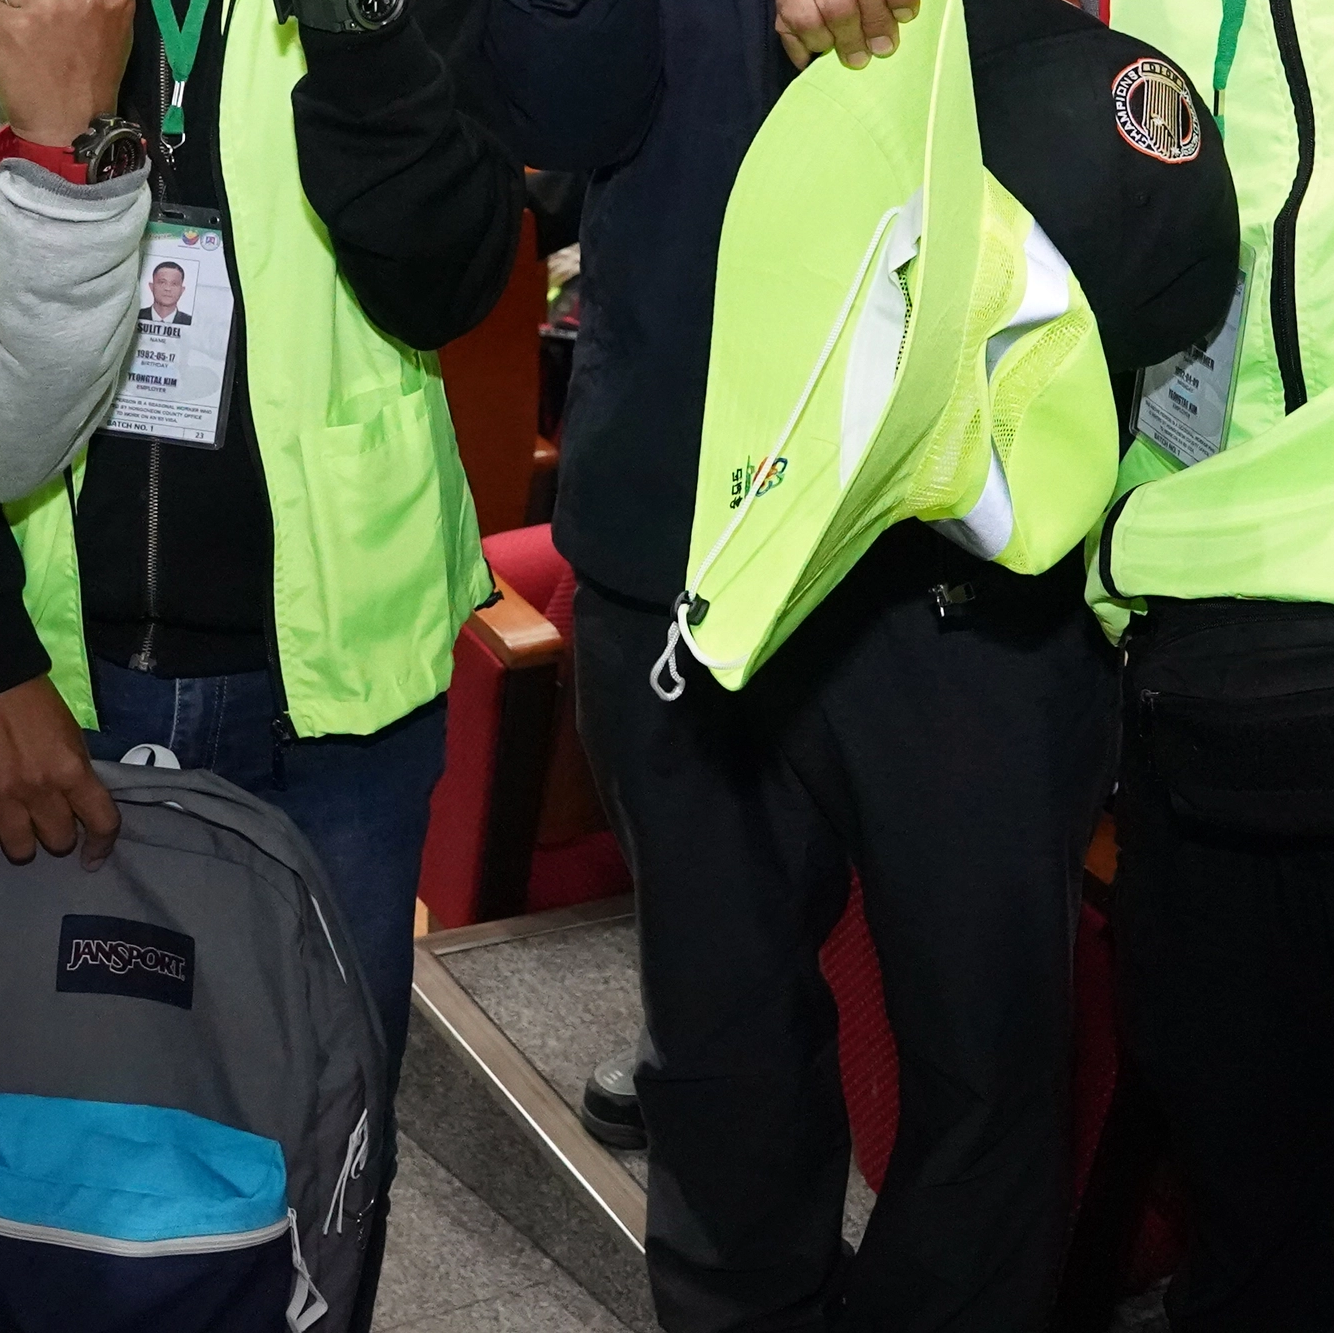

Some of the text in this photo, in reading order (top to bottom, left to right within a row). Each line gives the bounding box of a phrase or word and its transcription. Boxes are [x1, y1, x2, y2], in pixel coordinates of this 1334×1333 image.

[163, 326, 181, 337] JOEL
[107, 419, 132, 429] BATCH
[134, 423, 148, 431] NO.
[67, 939, 185, 981] JANSPORT
